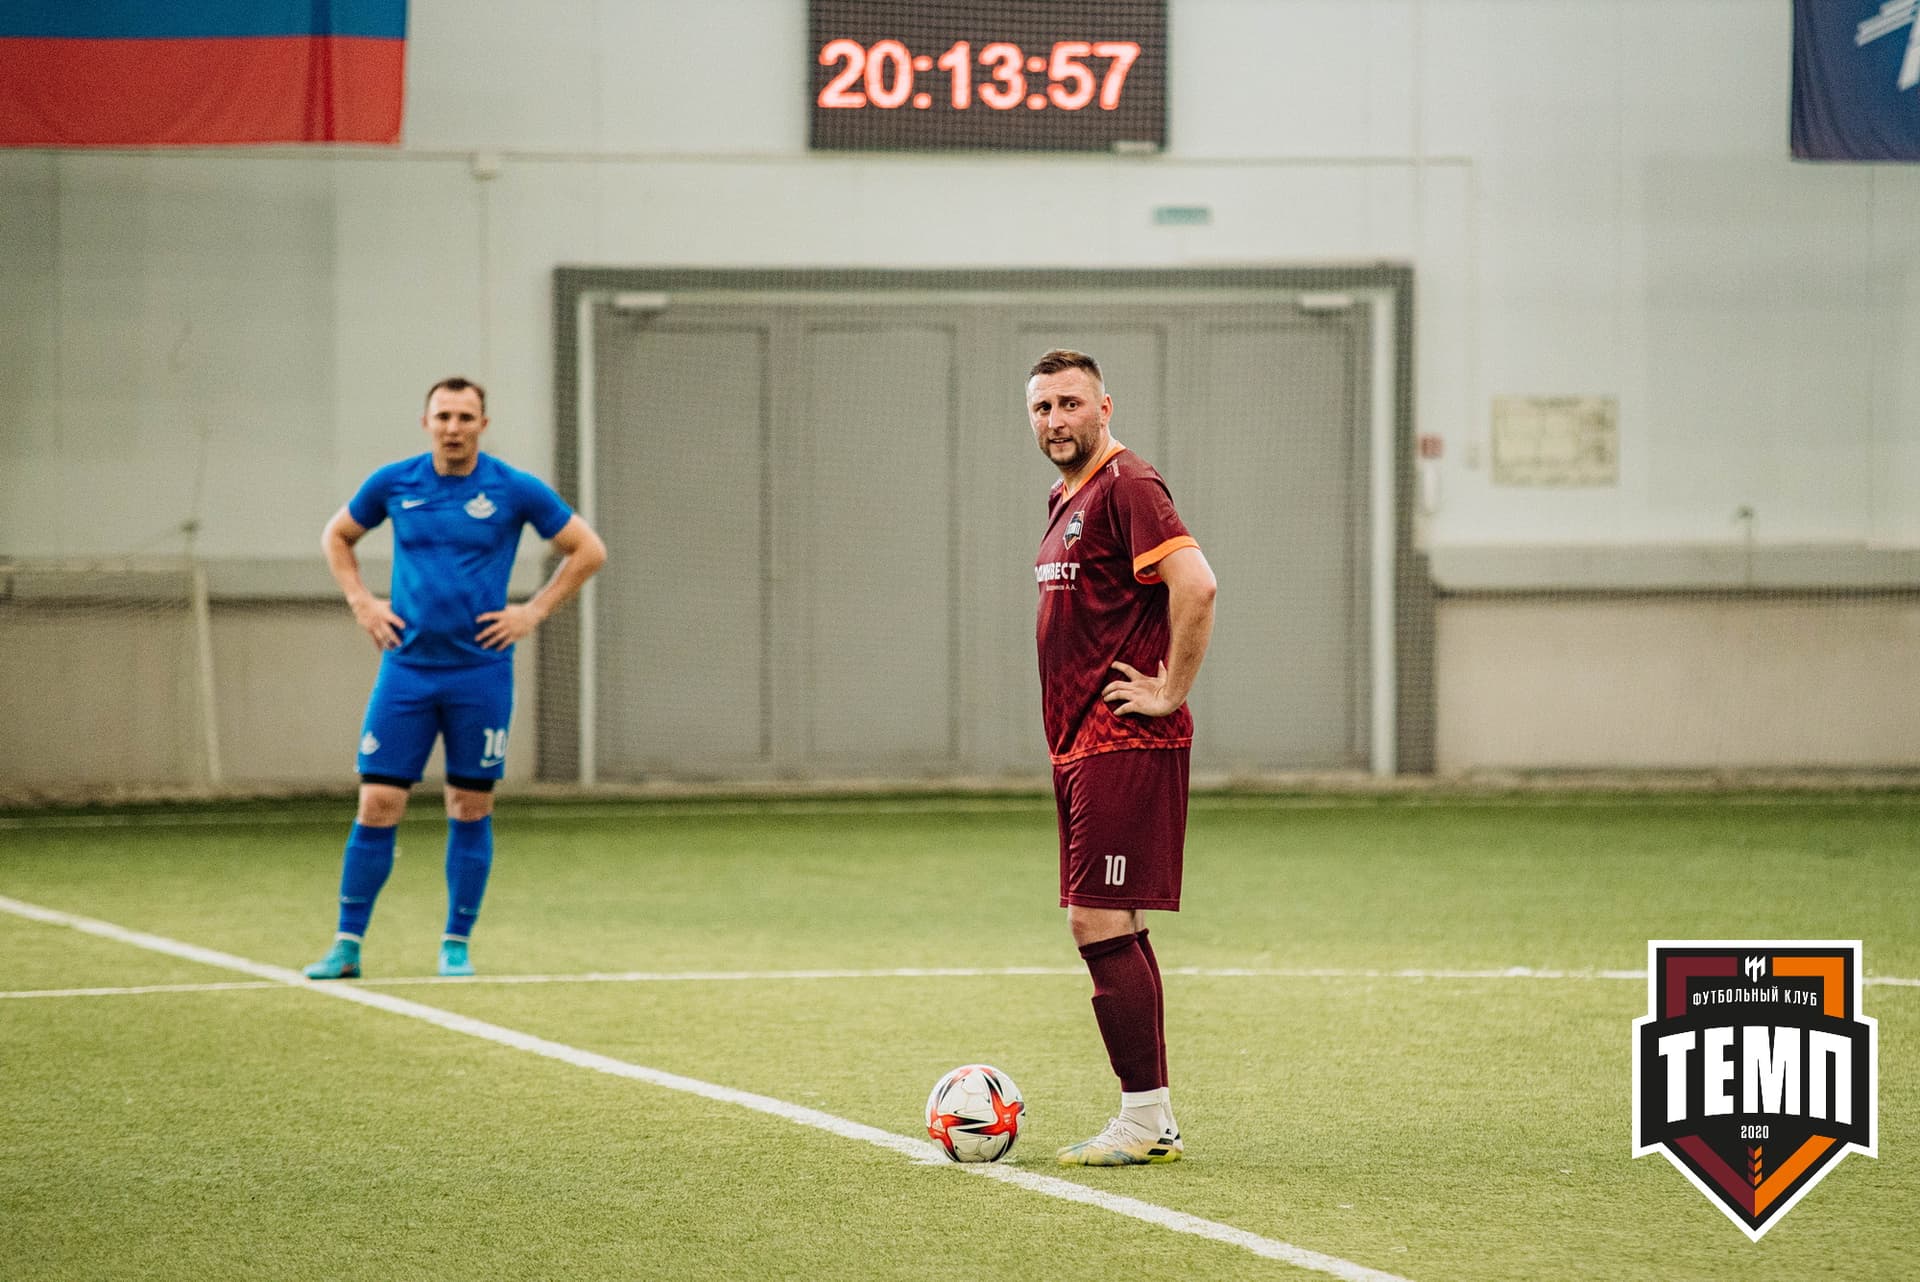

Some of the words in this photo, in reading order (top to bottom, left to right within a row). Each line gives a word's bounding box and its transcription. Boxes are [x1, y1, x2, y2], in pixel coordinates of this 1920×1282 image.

[818, 38, 1141, 110] 20:13:57
[483, 728, 506, 758] 10
[1105, 855, 1126, 886] 10
